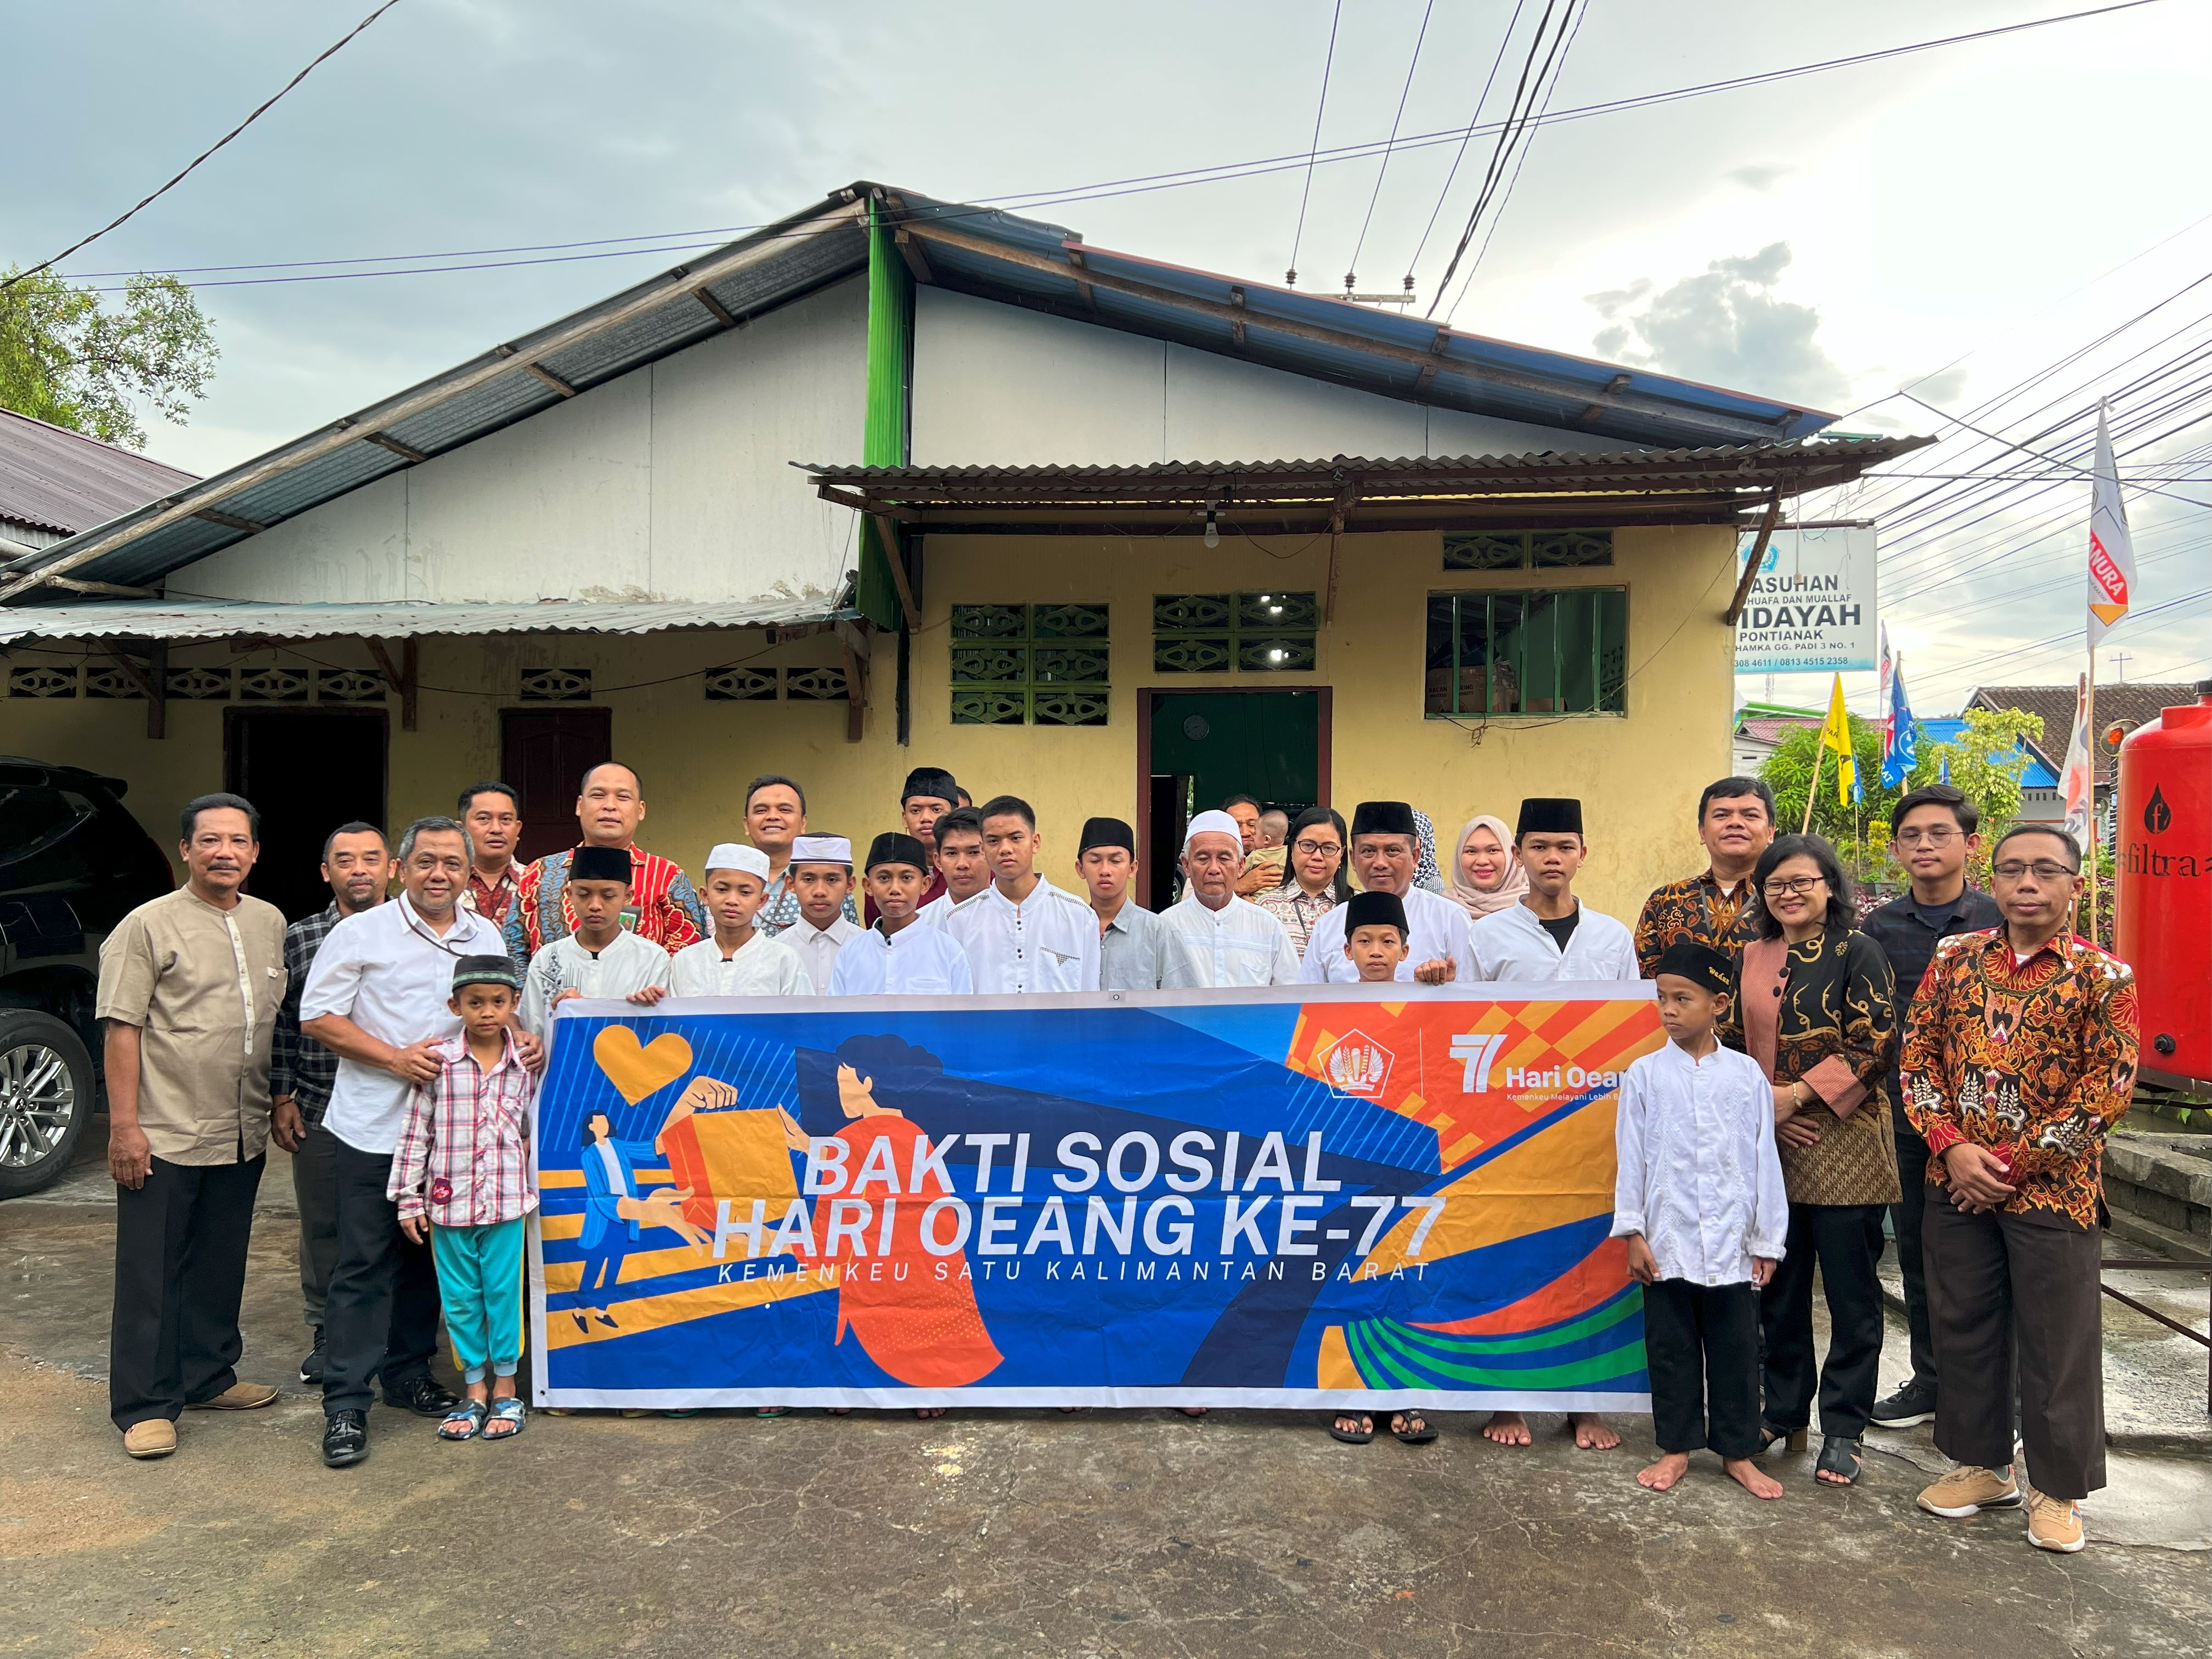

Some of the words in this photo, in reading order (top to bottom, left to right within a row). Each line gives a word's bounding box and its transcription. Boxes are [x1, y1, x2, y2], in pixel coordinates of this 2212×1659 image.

[1751, 575, 1838, 593] ASUHAN
[1747, 597, 1779, 605] HUAFA
[1783, 596, 1802, 604] DAN
[1806, 594, 1852, 603] MUALLAF
[1741, 604, 1861, 629] IDAYAH
[1740, 629, 1823, 641] PONTIANAK
[1774, 658, 1778, 667] /
[2128, 843, 2201, 877] filtra
[1506, 1065, 1560, 1088] Hari
[1551, 1092, 1587, 1102] Melayani
[803, 1133, 1030, 1195] BAKTI
[1052, 1131, 1341, 1192] SOSIAL
[713, 1198, 896, 1259] HARI
[919, 1195, 1195, 1256] OEANG
[1220, 1195, 1447, 1256] KE-77
[718, 1262, 909, 1283] KEMENKEU
[934, 1261, 1020, 1280] SATU
[1046, 1261, 1284, 1280] KALIMANTAN
[1312, 1262, 1429, 1280] BARAT
